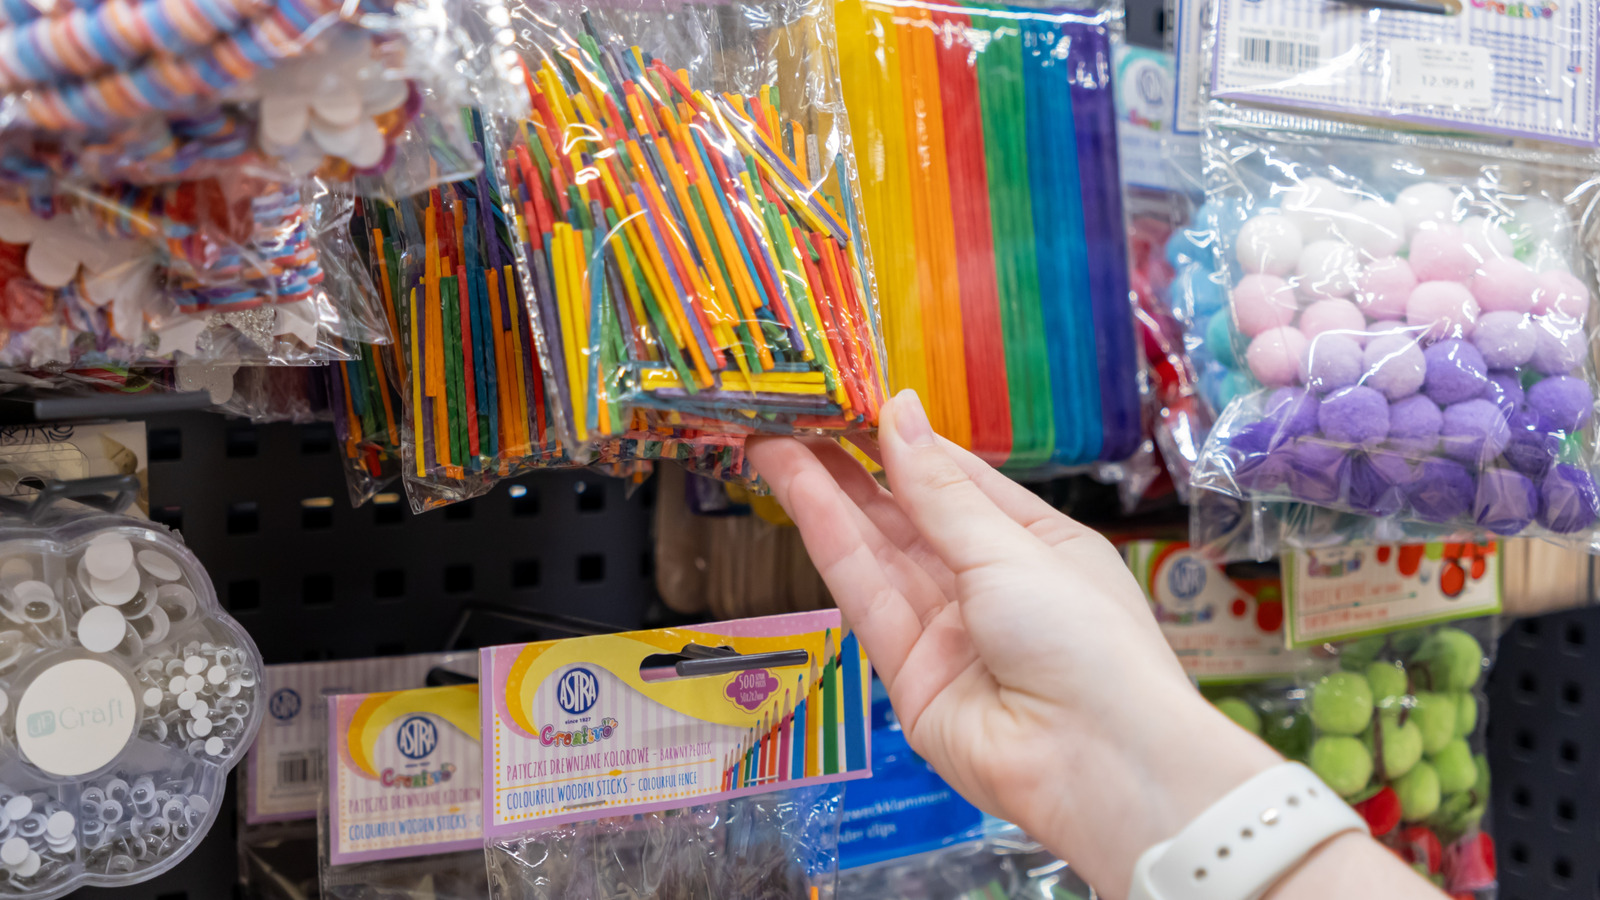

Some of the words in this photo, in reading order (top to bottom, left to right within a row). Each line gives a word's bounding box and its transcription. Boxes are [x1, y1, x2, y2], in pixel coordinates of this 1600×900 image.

[560, 671, 597, 712] ASTRA
[738, 673, 755, 690] 500
[59, 698, 124, 730] Craft
[400, 720, 435, 757] ASTRA
[506, 760, 547, 782] PATYCZKI
[550, 753, 601, 776] DREWNIANE
[603, 746, 649, 767] KOLOROWE
[660, 744, 688, 761] BARWNY
[689, 741, 712, 757] PŁOTEK
[506, 787, 555, 810] COLOURFUL
[557, 781, 594, 802] WOODEN
[596, 777, 628, 797] STICKS
[638, 774, 676, 792] COLOURFUL
[678, 771, 697, 786] FENCE
[348, 821, 396, 841] COLOURFUL
[398, 817, 435, 835] WOODEN
[436, 814, 467, 832] STICKS
